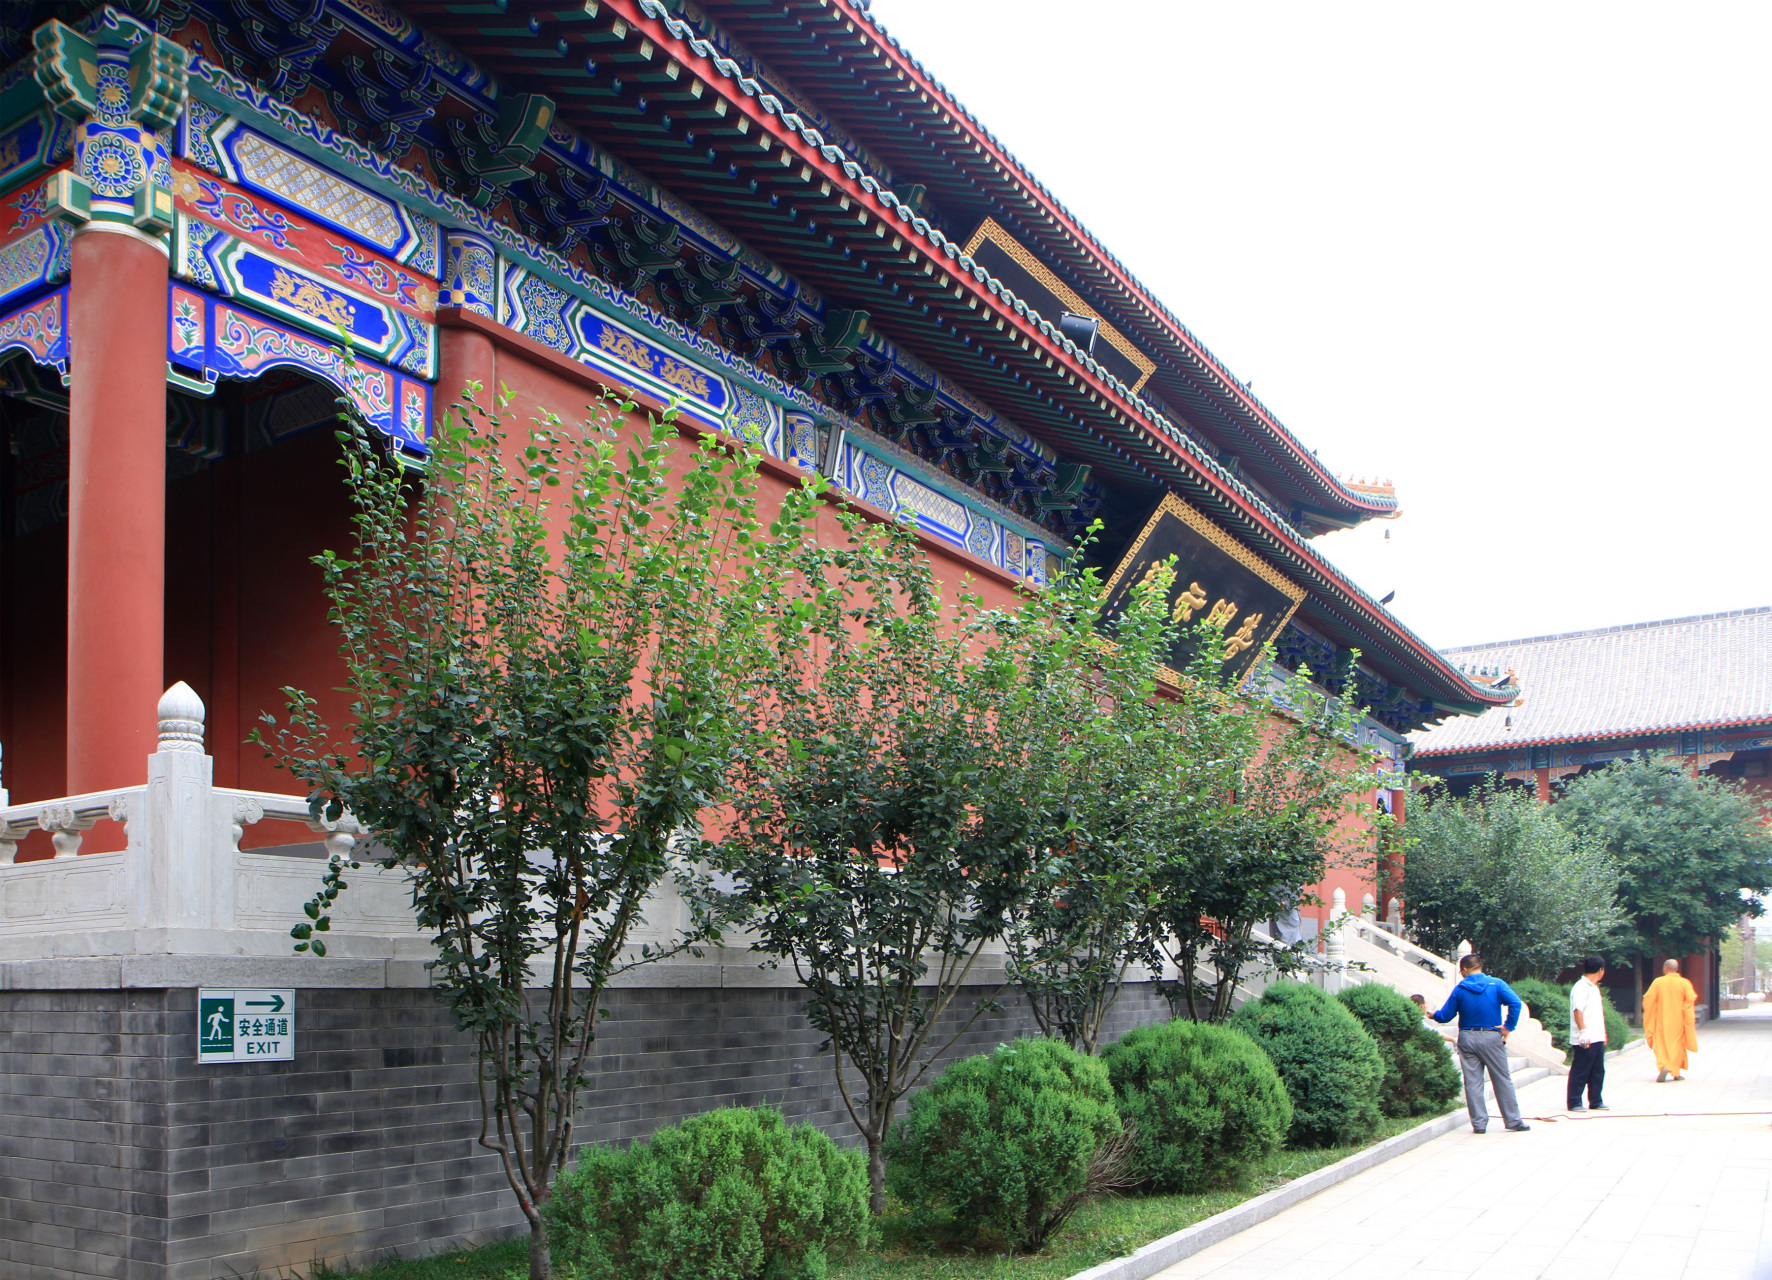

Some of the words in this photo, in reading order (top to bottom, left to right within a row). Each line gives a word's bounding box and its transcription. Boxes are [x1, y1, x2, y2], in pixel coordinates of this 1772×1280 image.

[239, 1018, 288, 1037] 安全通道
[246, 1041, 280, 1054] EXIT
